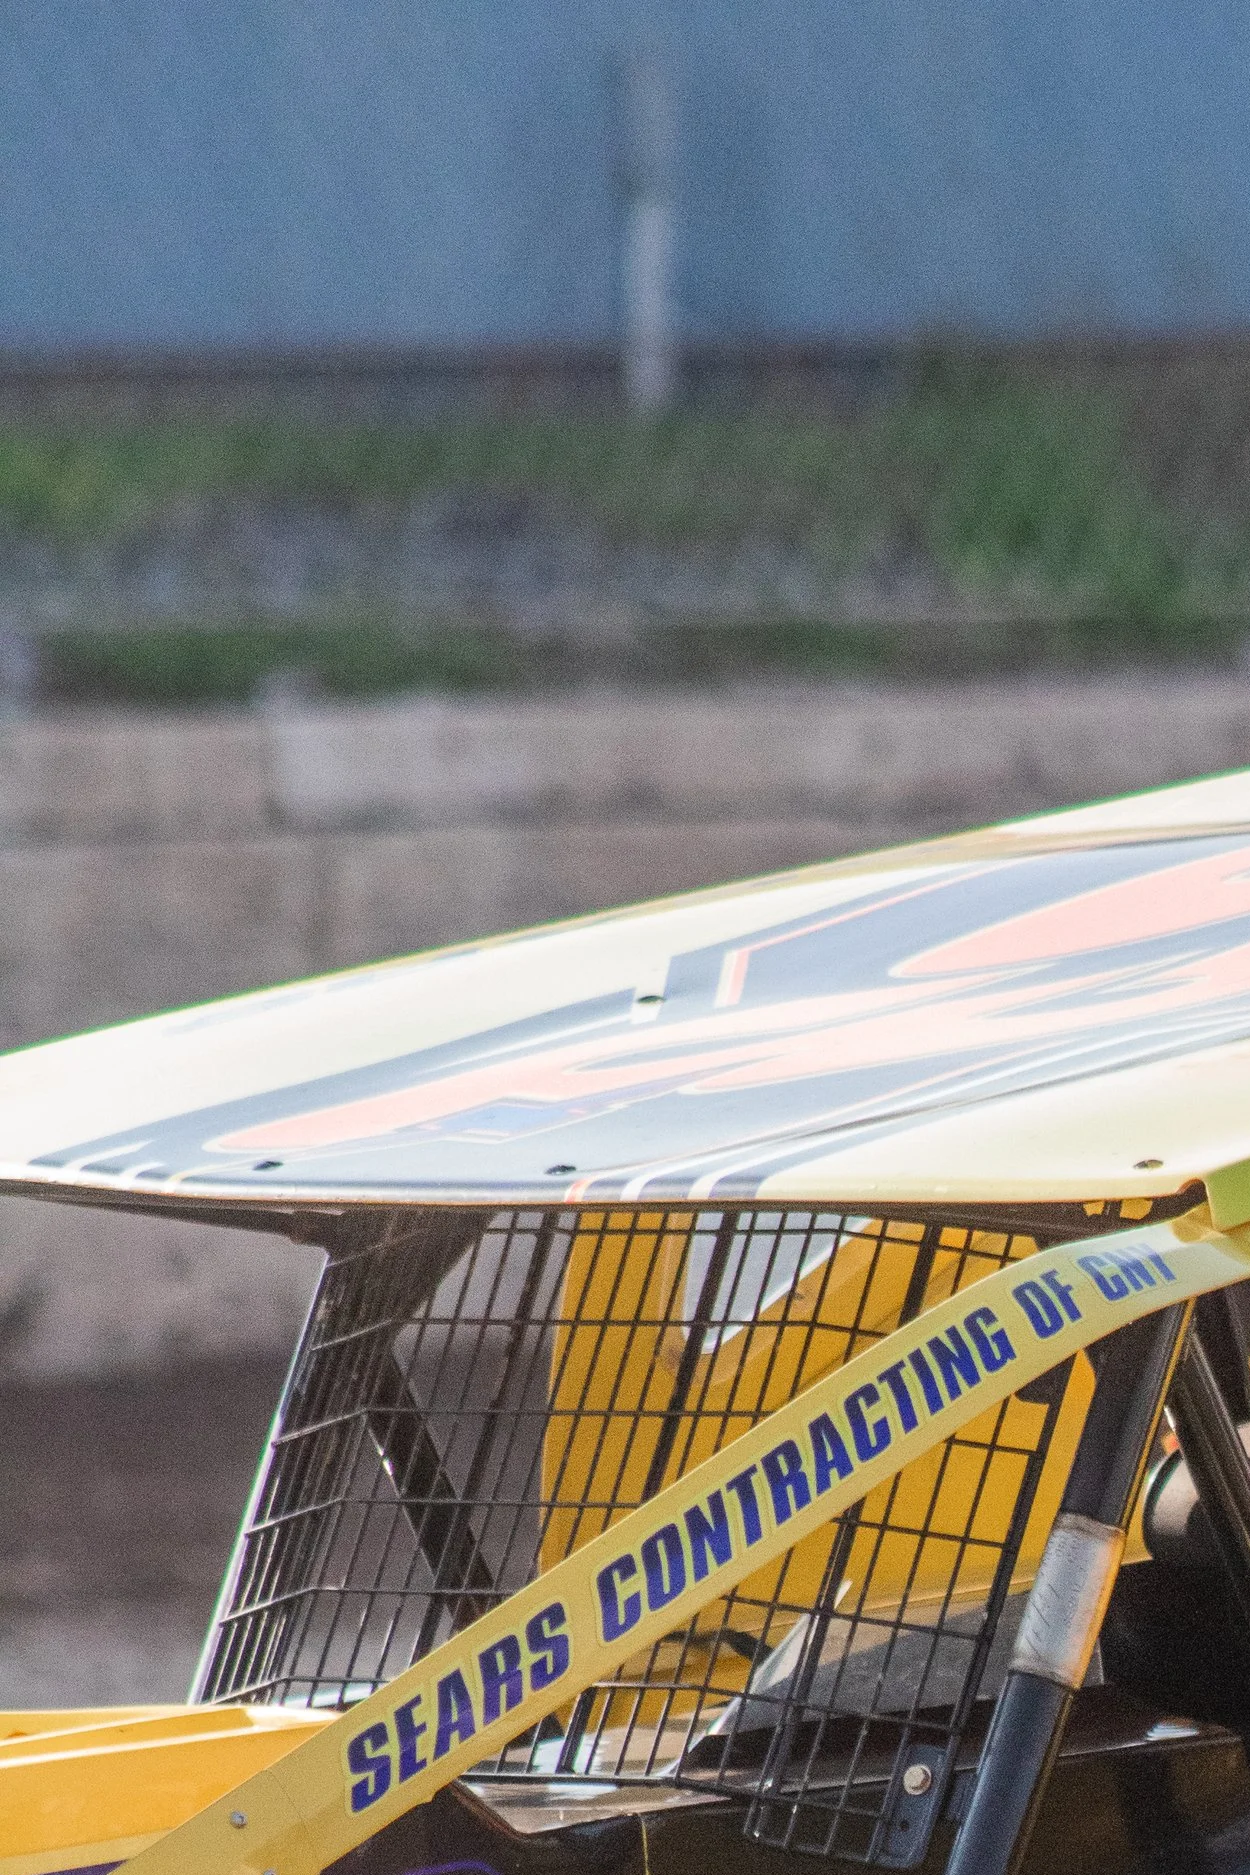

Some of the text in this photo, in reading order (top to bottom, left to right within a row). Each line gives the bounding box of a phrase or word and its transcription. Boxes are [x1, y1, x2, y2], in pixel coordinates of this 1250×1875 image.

[347, 1603, 569, 1813] SEARS
[597, 1306, 1015, 1643] CONTRACTING
[1011, 1268, 1082, 1339] OF
[1076, 1243, 1177, 1301] CNY
